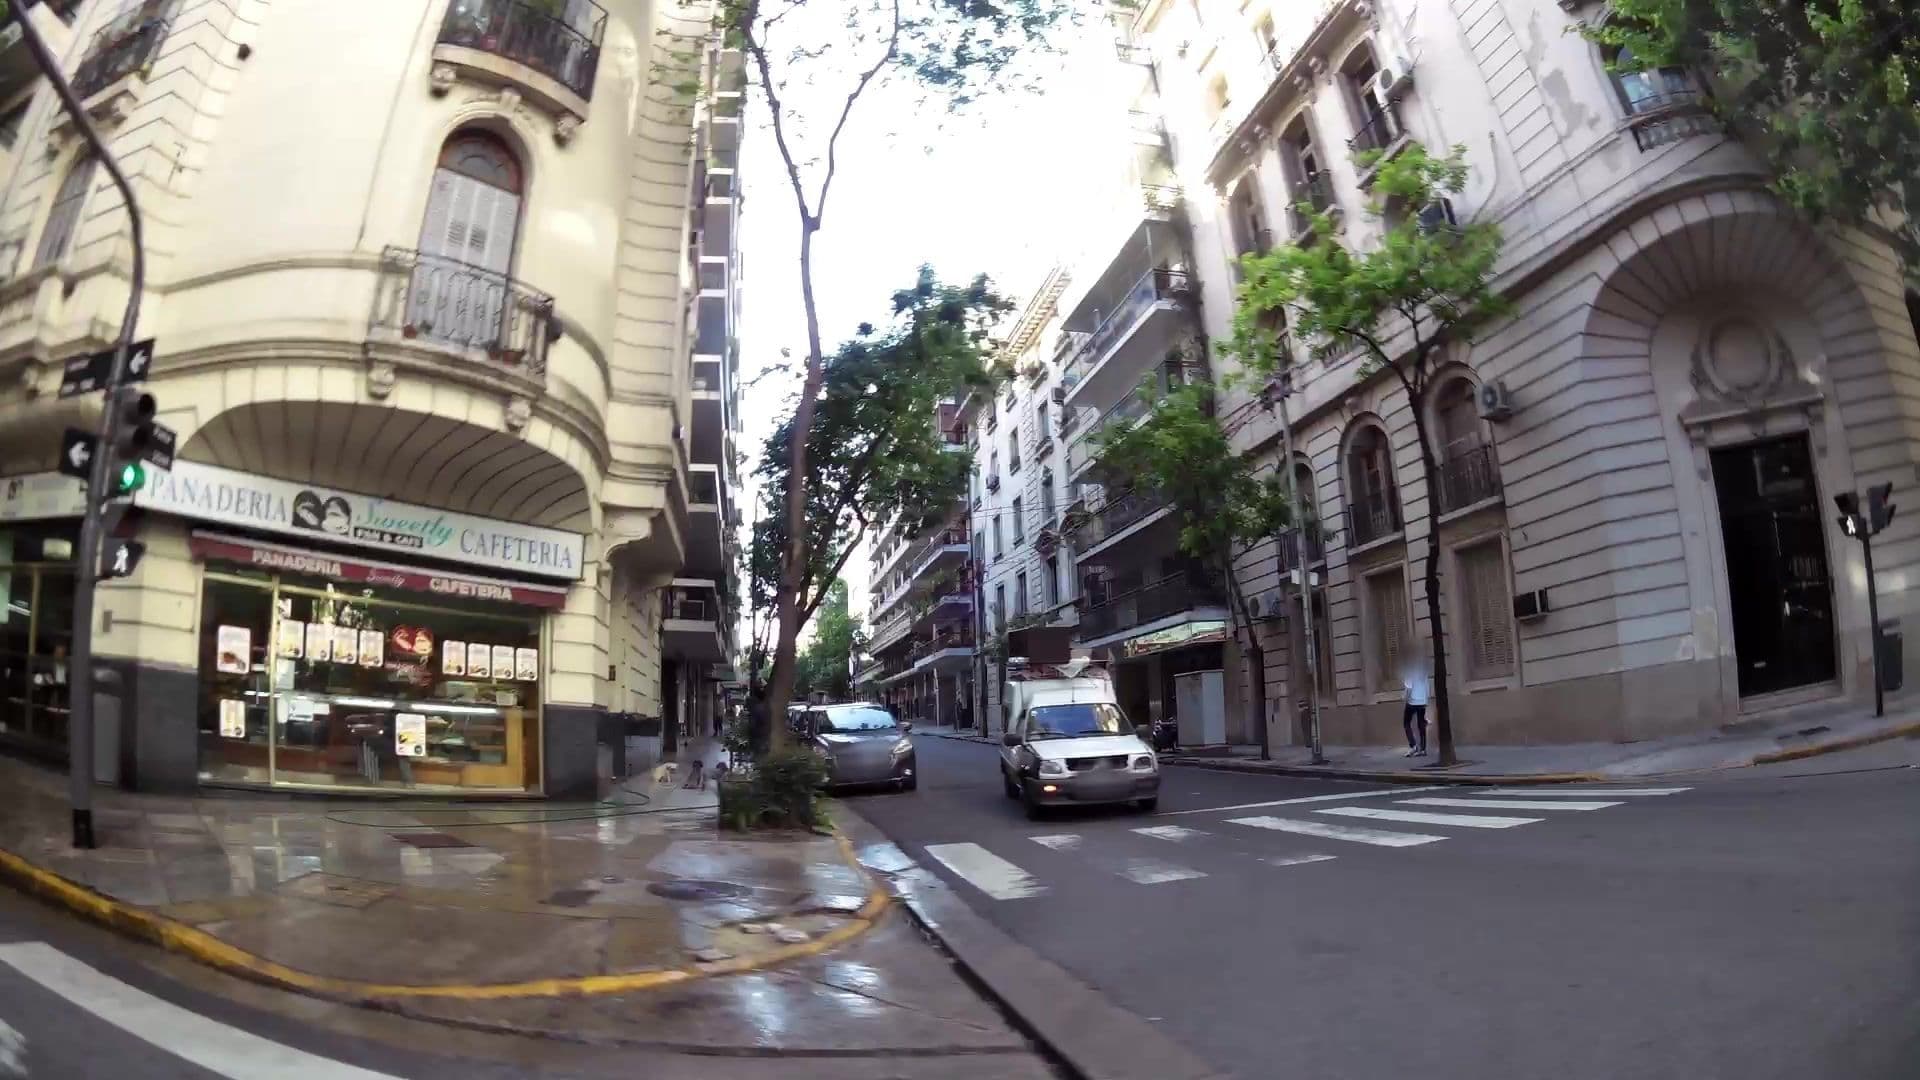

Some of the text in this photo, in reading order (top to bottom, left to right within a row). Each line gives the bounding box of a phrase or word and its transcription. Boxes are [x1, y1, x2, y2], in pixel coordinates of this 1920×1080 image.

[355, 499, 456, 547] Sweetly
[252, 549, 342, 577] PANADERIA
[459, 528, 572, 569] CAFETERIA
[429, 577, 513, 601] CAFETERIA
